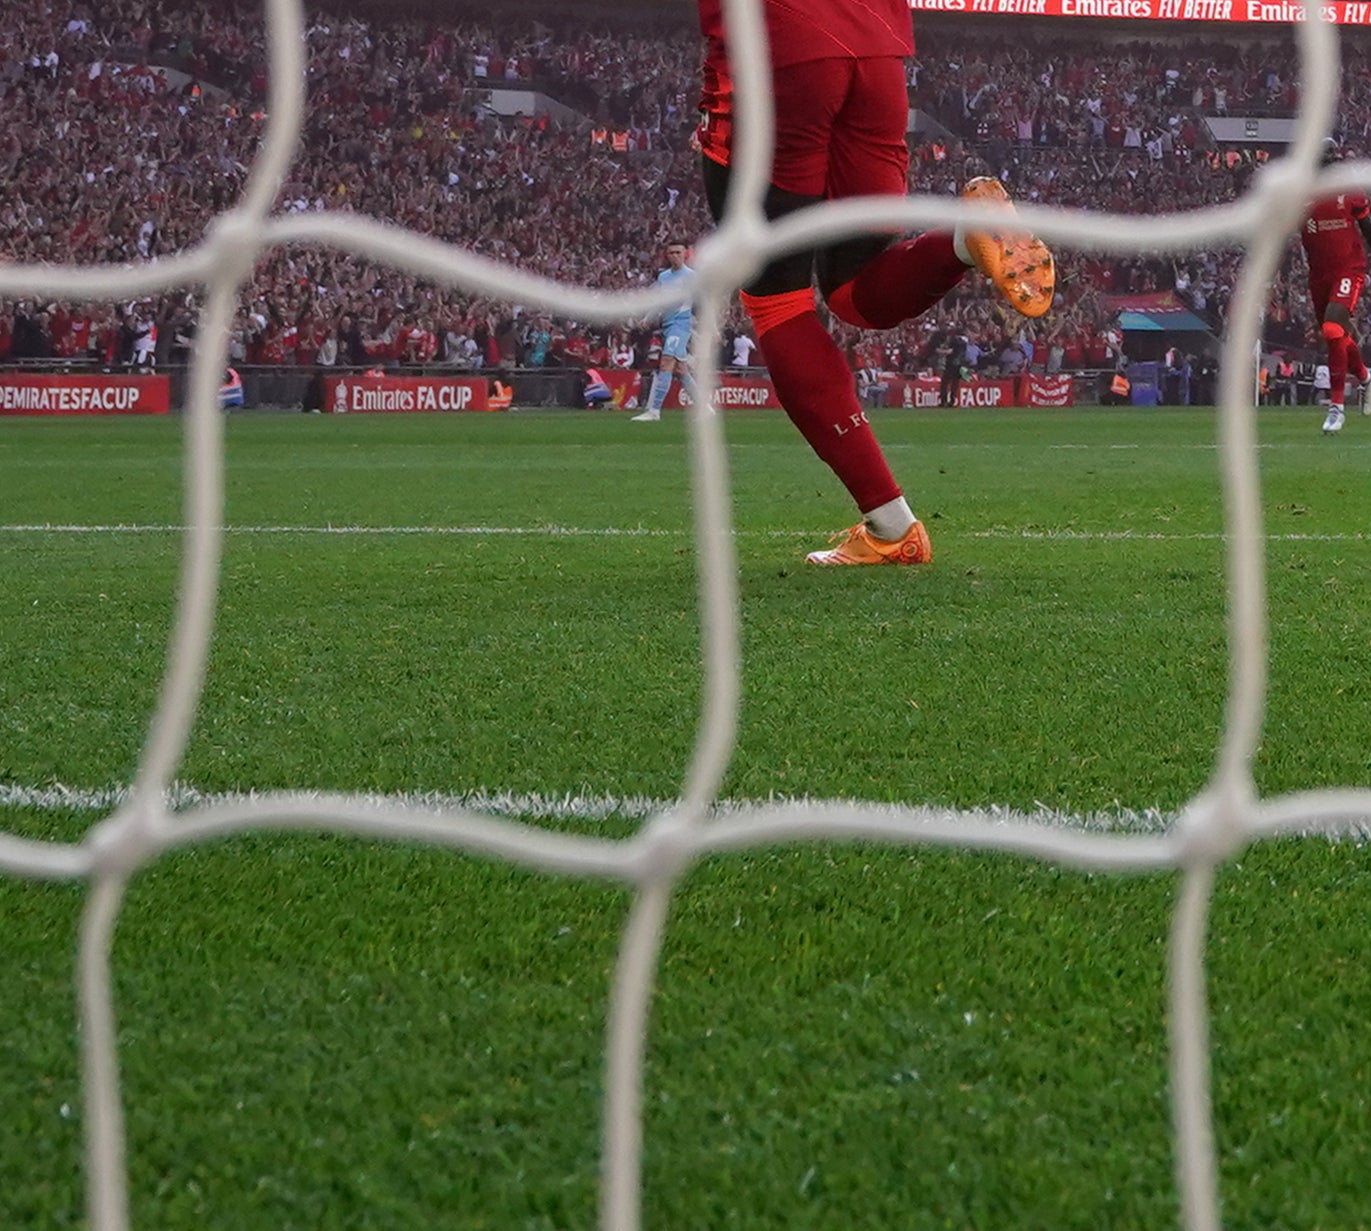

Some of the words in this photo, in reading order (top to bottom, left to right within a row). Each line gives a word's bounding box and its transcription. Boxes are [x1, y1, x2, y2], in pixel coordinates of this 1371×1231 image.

[1184, 0, 1233, 19] BETTER
[1247, 0, 1337, 24] Emiraes
[1344, 3, 1367, 23] FLY
[1339, 277, 1352, 295] 8
[352, 386, 414, 411] Emirates
[417, 386, 436, 409] FA
[438, 386, 472, 410] CUP
[960, 387, 974, 406] FA
[976, 387, 1001, 406] CUP
